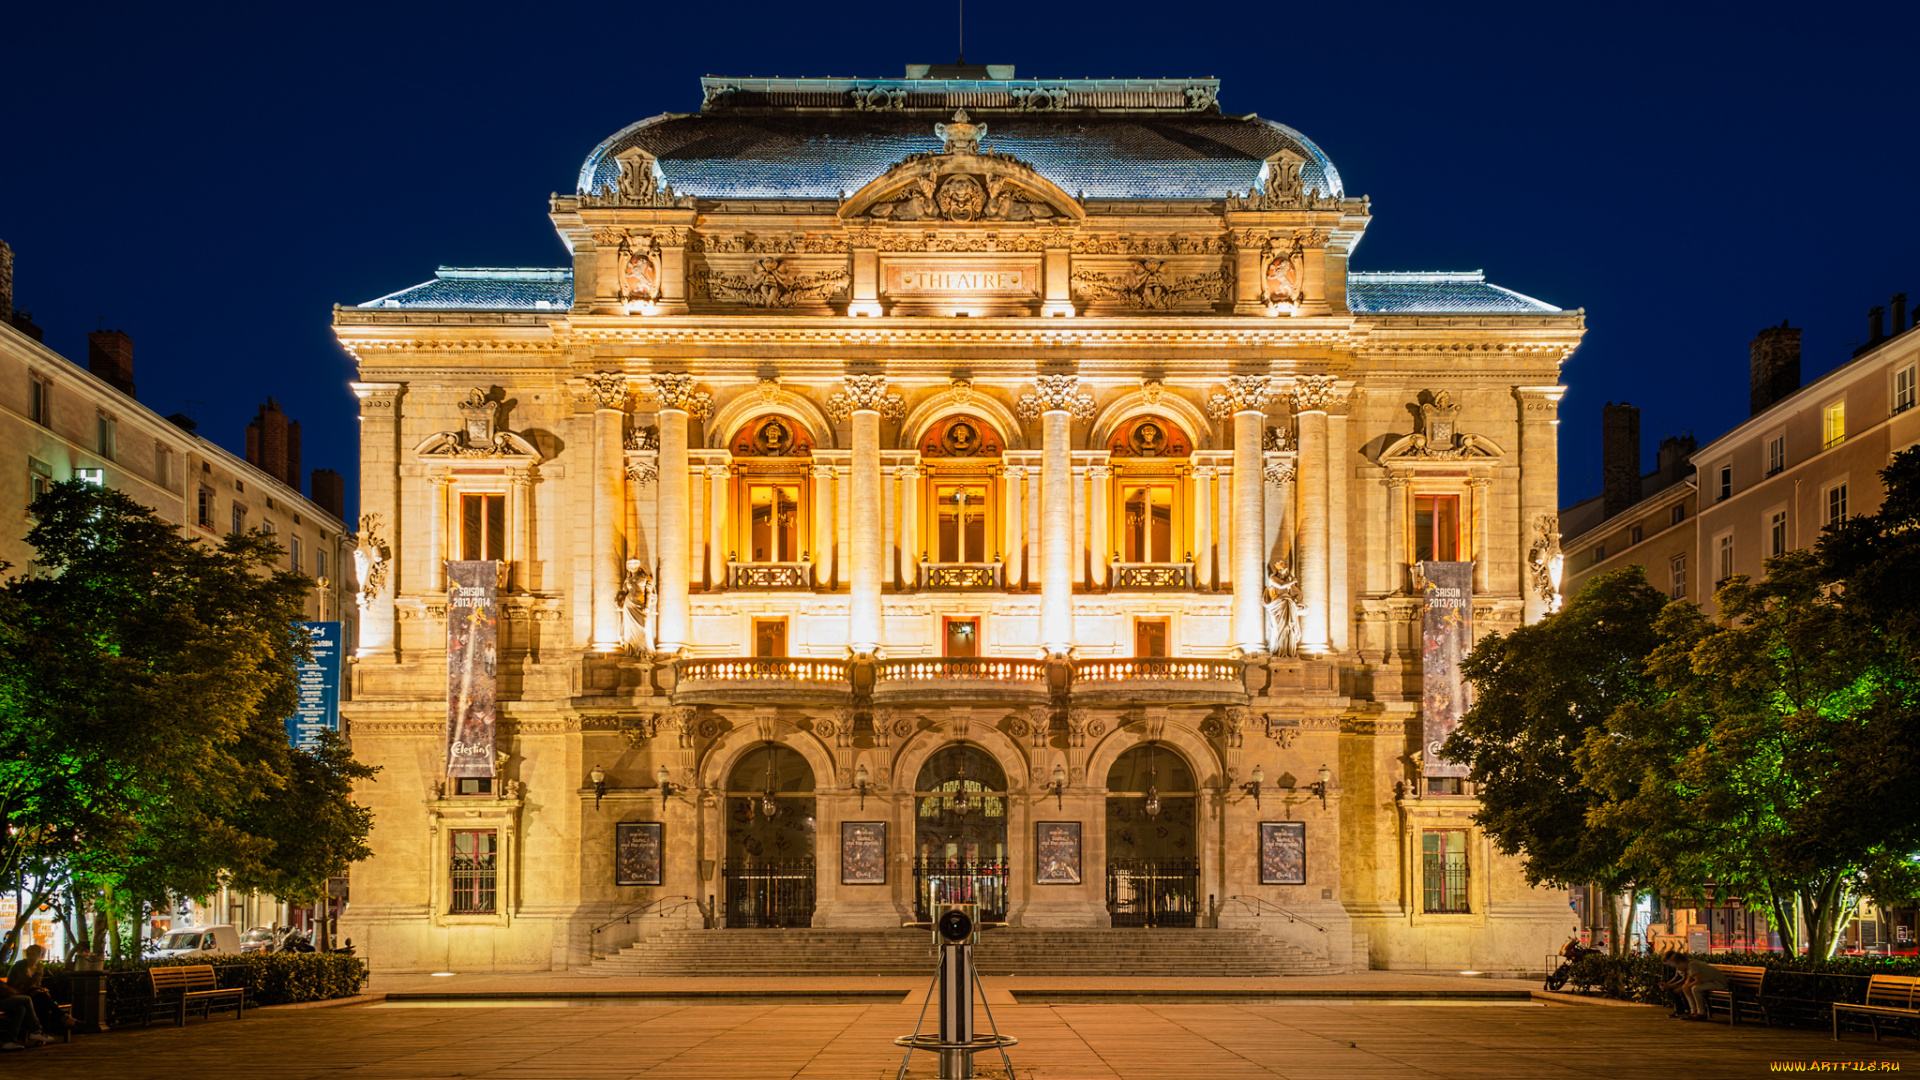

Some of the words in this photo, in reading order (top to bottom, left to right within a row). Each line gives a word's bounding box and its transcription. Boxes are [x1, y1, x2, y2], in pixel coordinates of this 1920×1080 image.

[914, 272, 1008, 288] THEATRE
[459, 587, 485, 597] SAISON
[1435, 588, 1461, 597] SAISON
[453, 598, 490, 607] 2013/2014
[1429, 598, 1466, 608] 2013/2014
